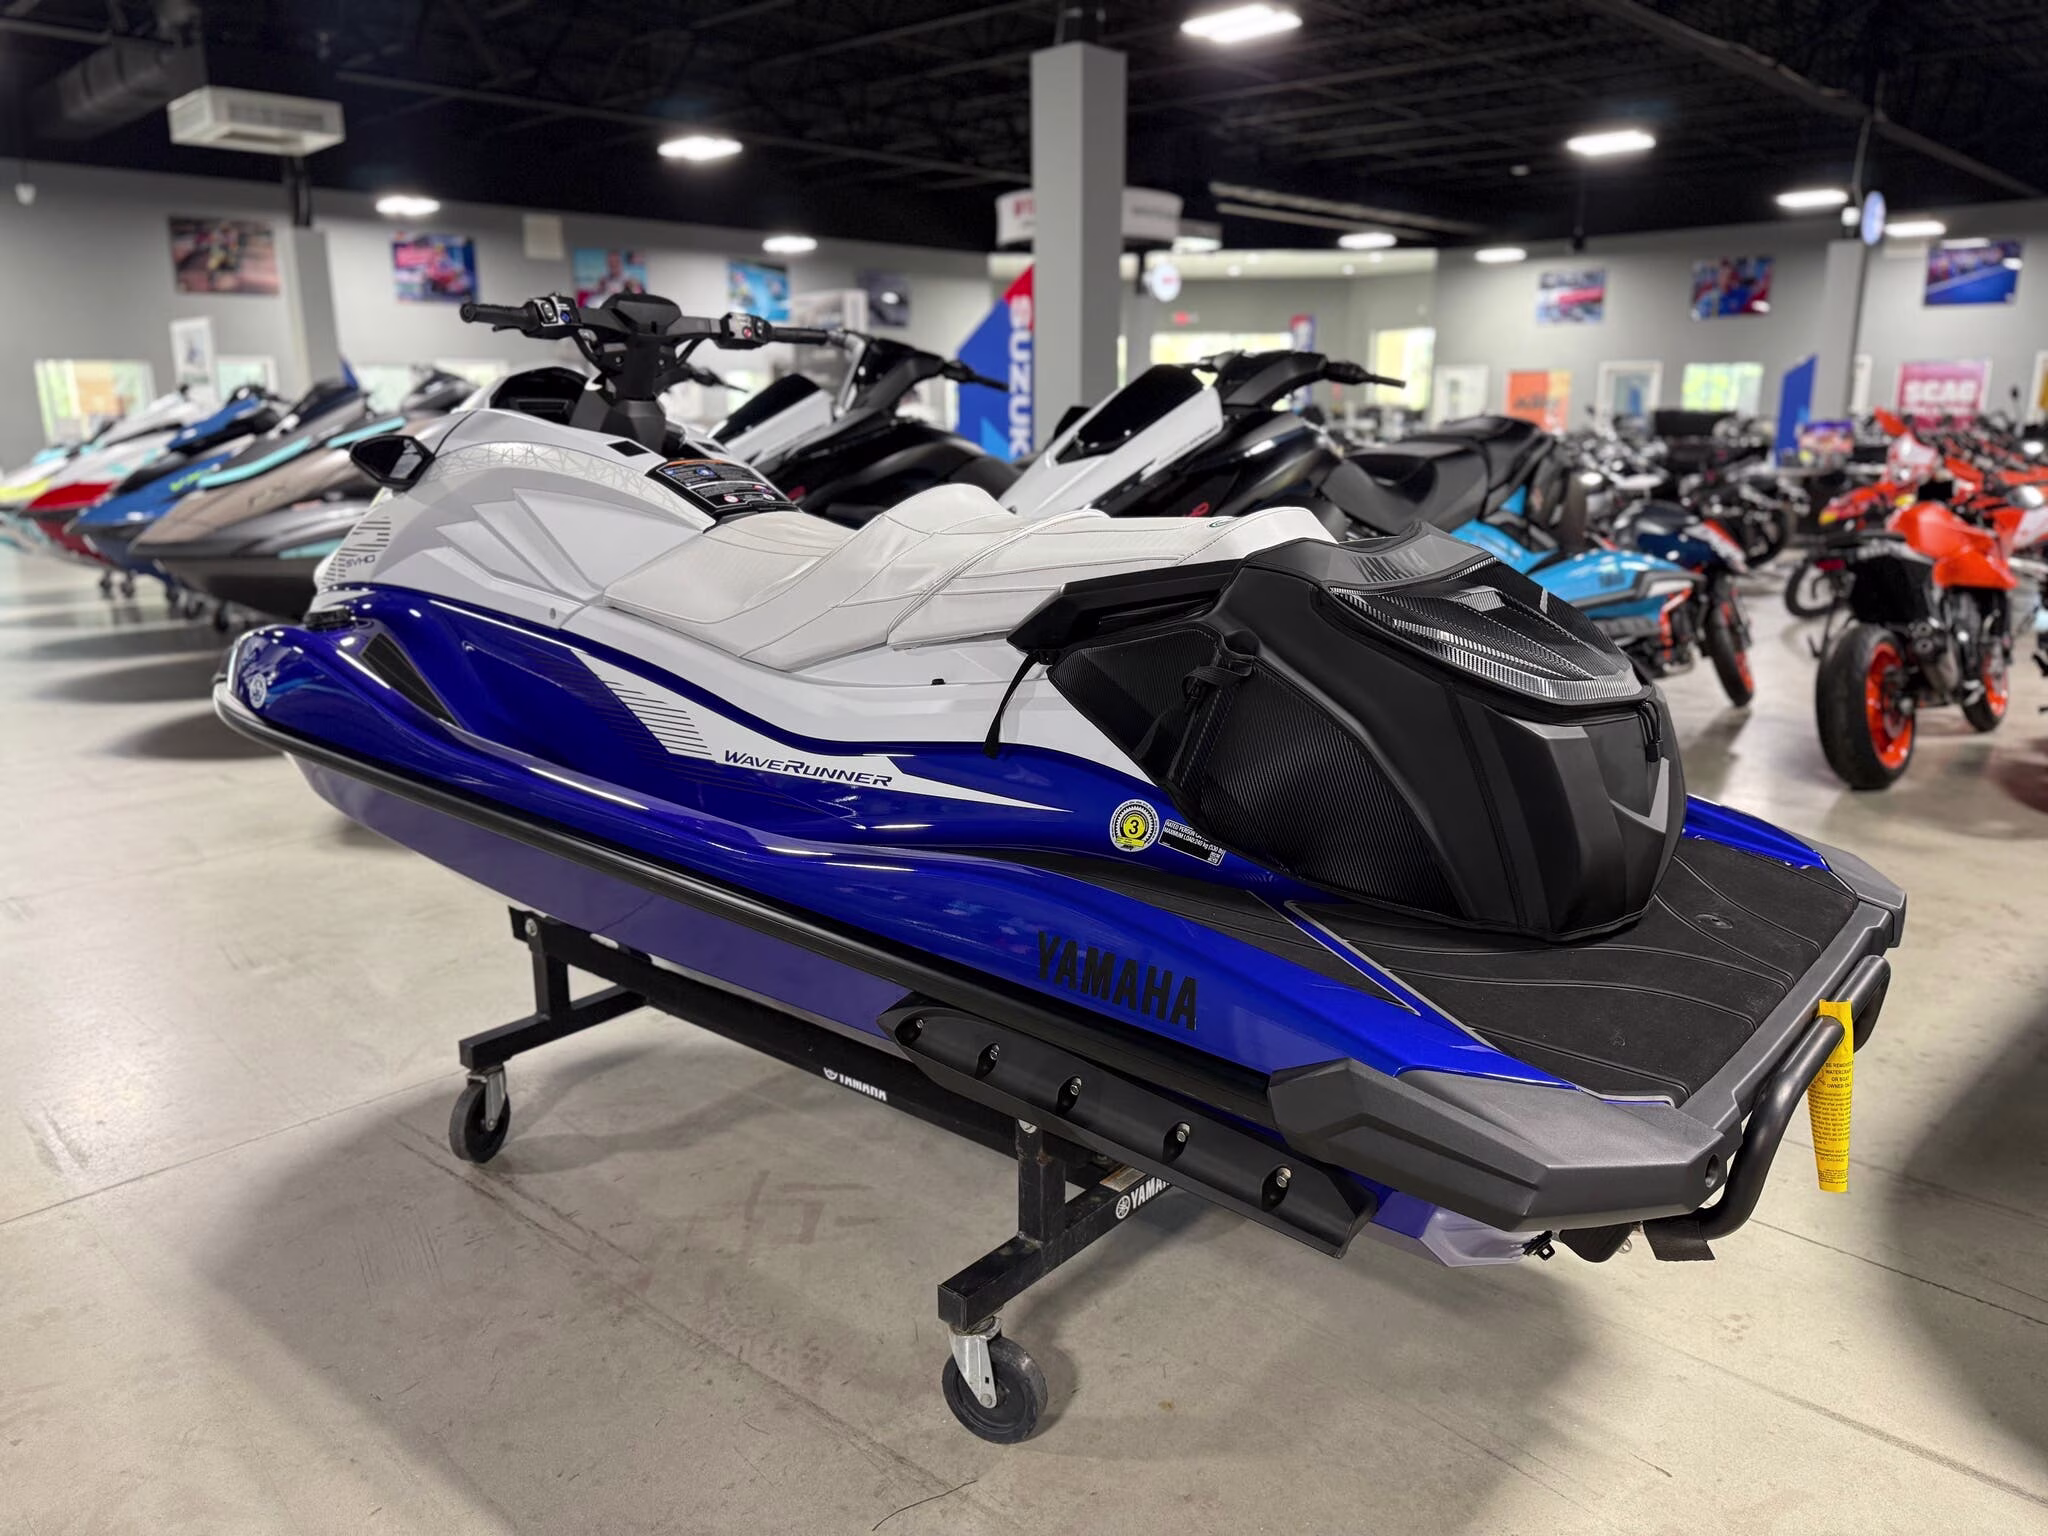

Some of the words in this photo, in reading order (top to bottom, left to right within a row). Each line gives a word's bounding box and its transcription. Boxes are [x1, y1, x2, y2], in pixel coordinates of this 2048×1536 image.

[1009, 294, 1032, 460] SUZUK
[346, 554, 376, 568] SVHO
[724, 750, 893, 787] WAVERUNNER
[1129, 819, 1140, 835] 3
[1038, 930, 1197, 1031] YAMAHA
[1131, 1177, 1170, 1210] YAMA
